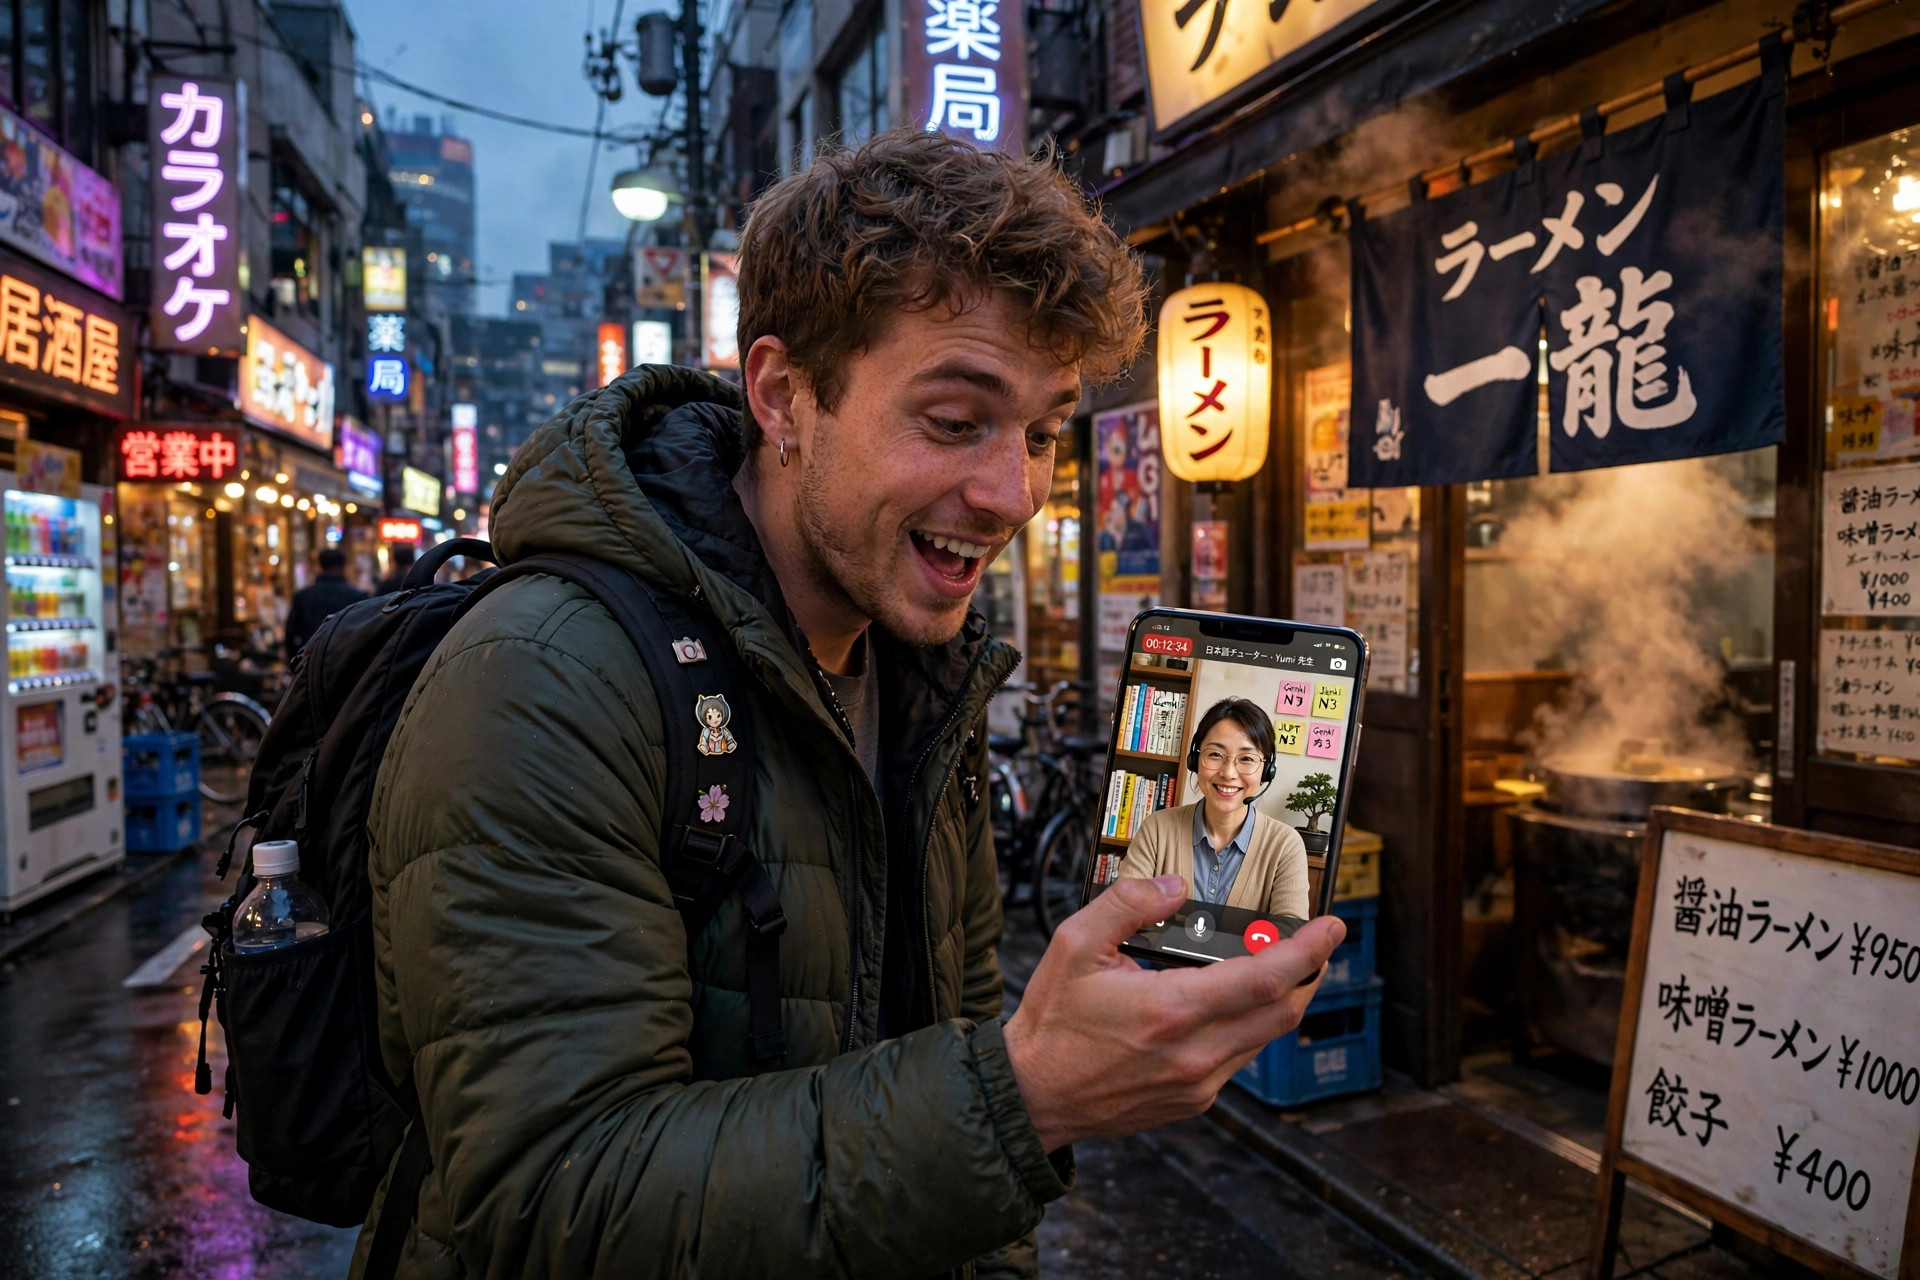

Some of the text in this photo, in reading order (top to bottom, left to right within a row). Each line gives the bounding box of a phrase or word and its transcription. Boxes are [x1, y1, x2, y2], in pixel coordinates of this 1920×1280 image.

[925, 0, 1001, 141] 薬局
[160, 82, 230, 342] カラオケ
[1435, 173, 1660, 302] ラーメン
[0, 274, 119, 395] 居酒屋
[1184, 299, 1233, 461] ラーメン
[1424, 266, 1698, 439] 一龍
[122, 431, 236, 478] 営業中
[1837, 520, 1920, 548] 味噌ラーメ
[1860, 571, 1909, 589] ¥1000
[1146, 638, 1188, 652] 00:12:34
[1868, 590, 1911, 610] ¥400
[1276, 653, 1297, 664] Yumi
[1319, 697, 1337, 710] N3
[1279, 734, 1297, 745] N3
[1674, 876, 1920, 984] 醤油ラーメン ¥950
[1658, 974, 1920, 1106] 味噌ラーメン ¥1000
[1645, 1067, 1871, 1211] 餃子 ¥400
